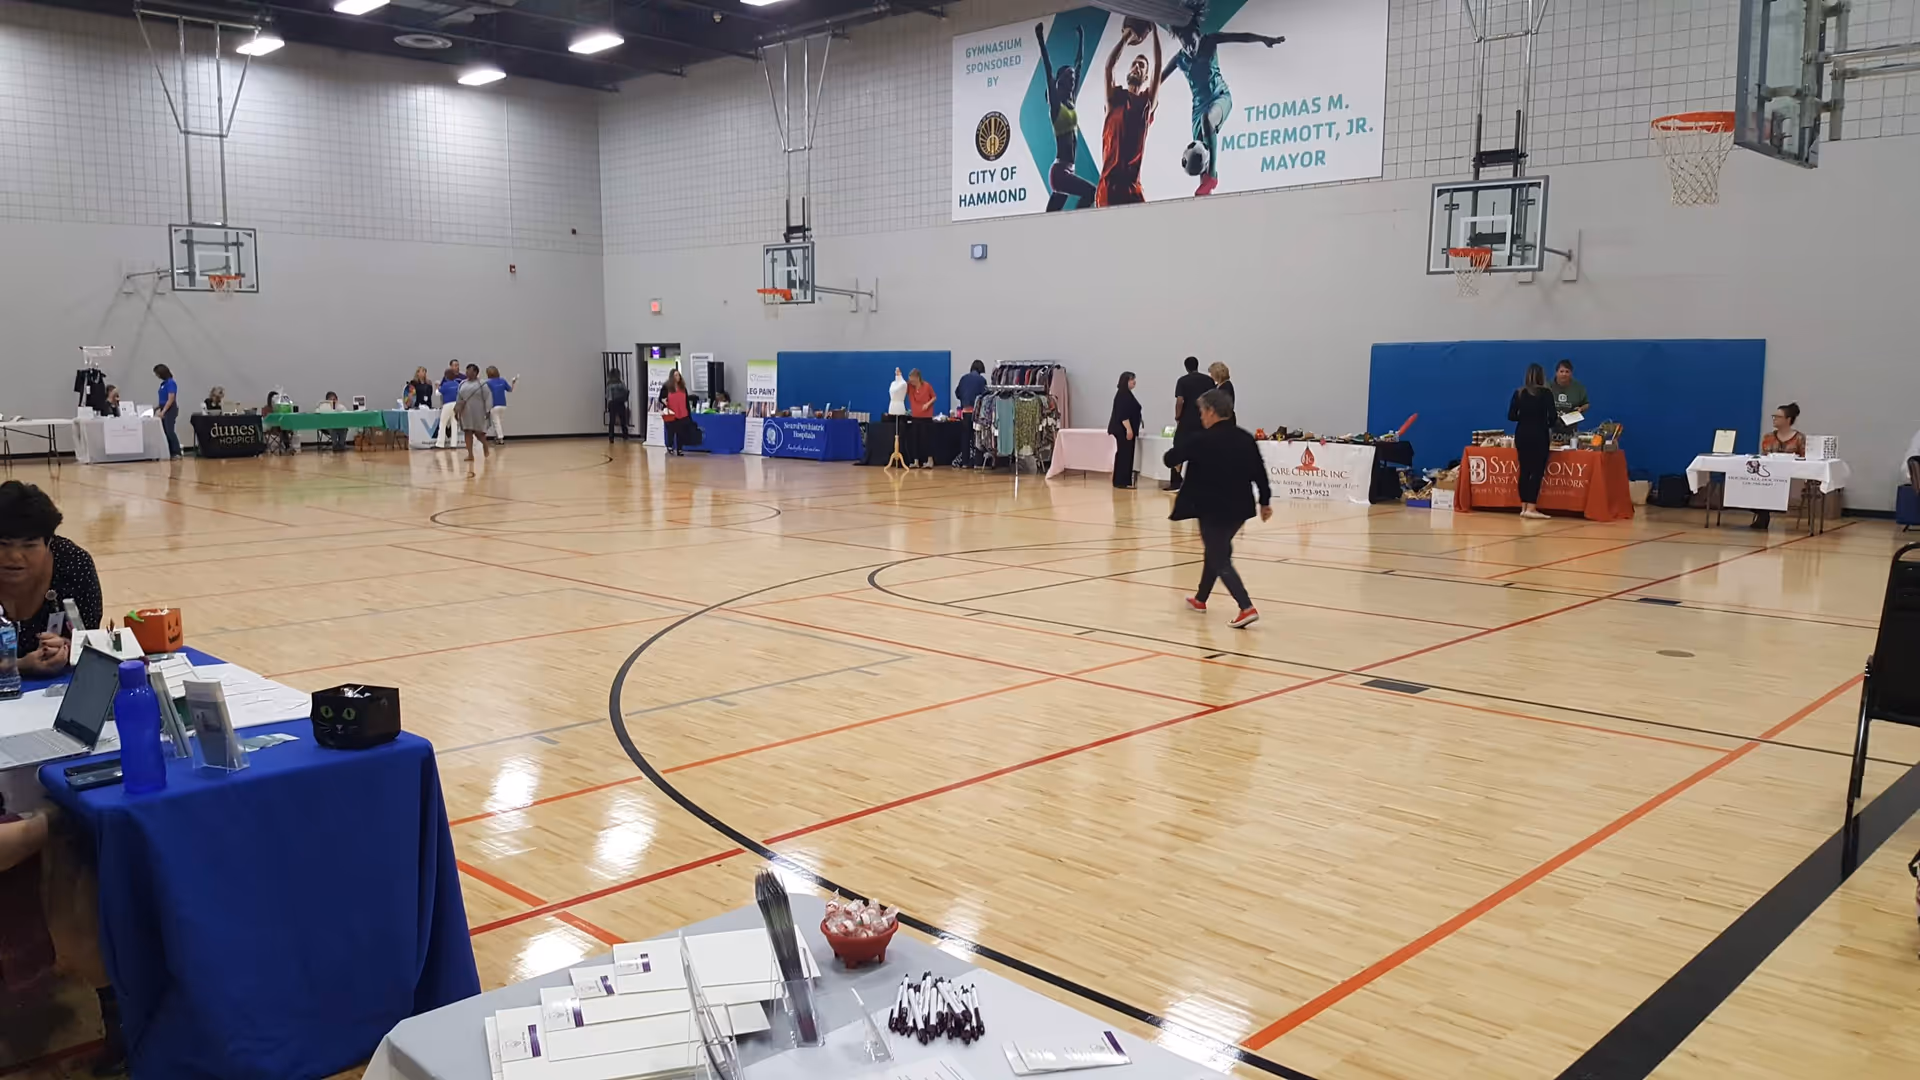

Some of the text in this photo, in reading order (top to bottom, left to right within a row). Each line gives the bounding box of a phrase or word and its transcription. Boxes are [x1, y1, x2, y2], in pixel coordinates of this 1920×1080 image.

[965, 37, 1022, 58] GYMNASIUM
[966, 55, 1022, 75] SPONSORED
[987, 76, 999, 87] BY
[1244, 94, 1349, 122] THOMAS M.
[1221, 117, 1374, 151] MCDERMOTT, JR.
[1261, 150, 1326, 172] MAYOR
[968, 166, 1017, 185] CITY OF
[959, 188, 1027, 208] HAMMOND
[759, 388, 775, 396] PAIN?
[210, 423, 255, 437] dunes
[793, 431, 816, 440] Hospitals
[220, 436, 255, 444] HOSPICE
[1271, 466, 1290, 476] CARE
[1292, 467, 1328, 478] CENTER
[1490, 456, 1588, 477] SYMONY
[1542, 477, 1585, 488] NETWORK
